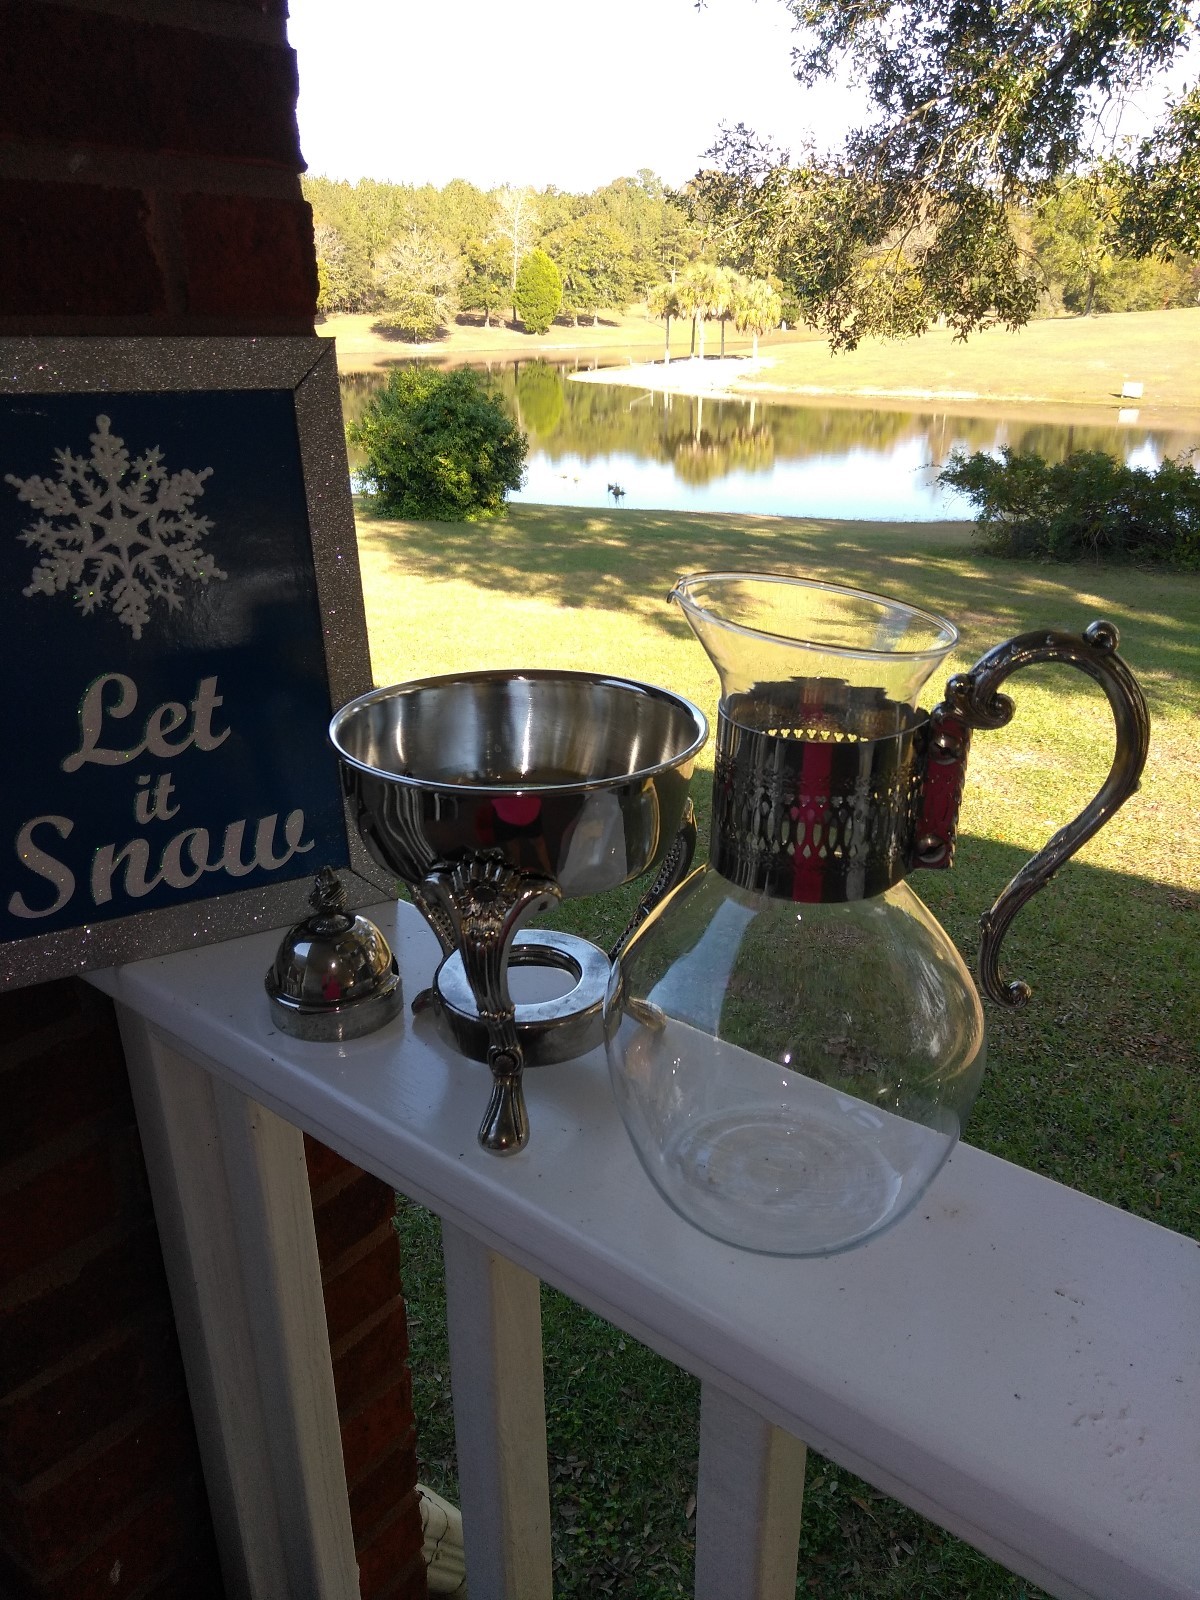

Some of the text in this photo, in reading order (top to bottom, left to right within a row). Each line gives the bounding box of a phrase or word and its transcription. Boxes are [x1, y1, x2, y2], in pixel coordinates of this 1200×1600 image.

[61, 673, 231, 773] Let
[135, 773, 181, 825] it
[7, 809, 315, 919] Snow
